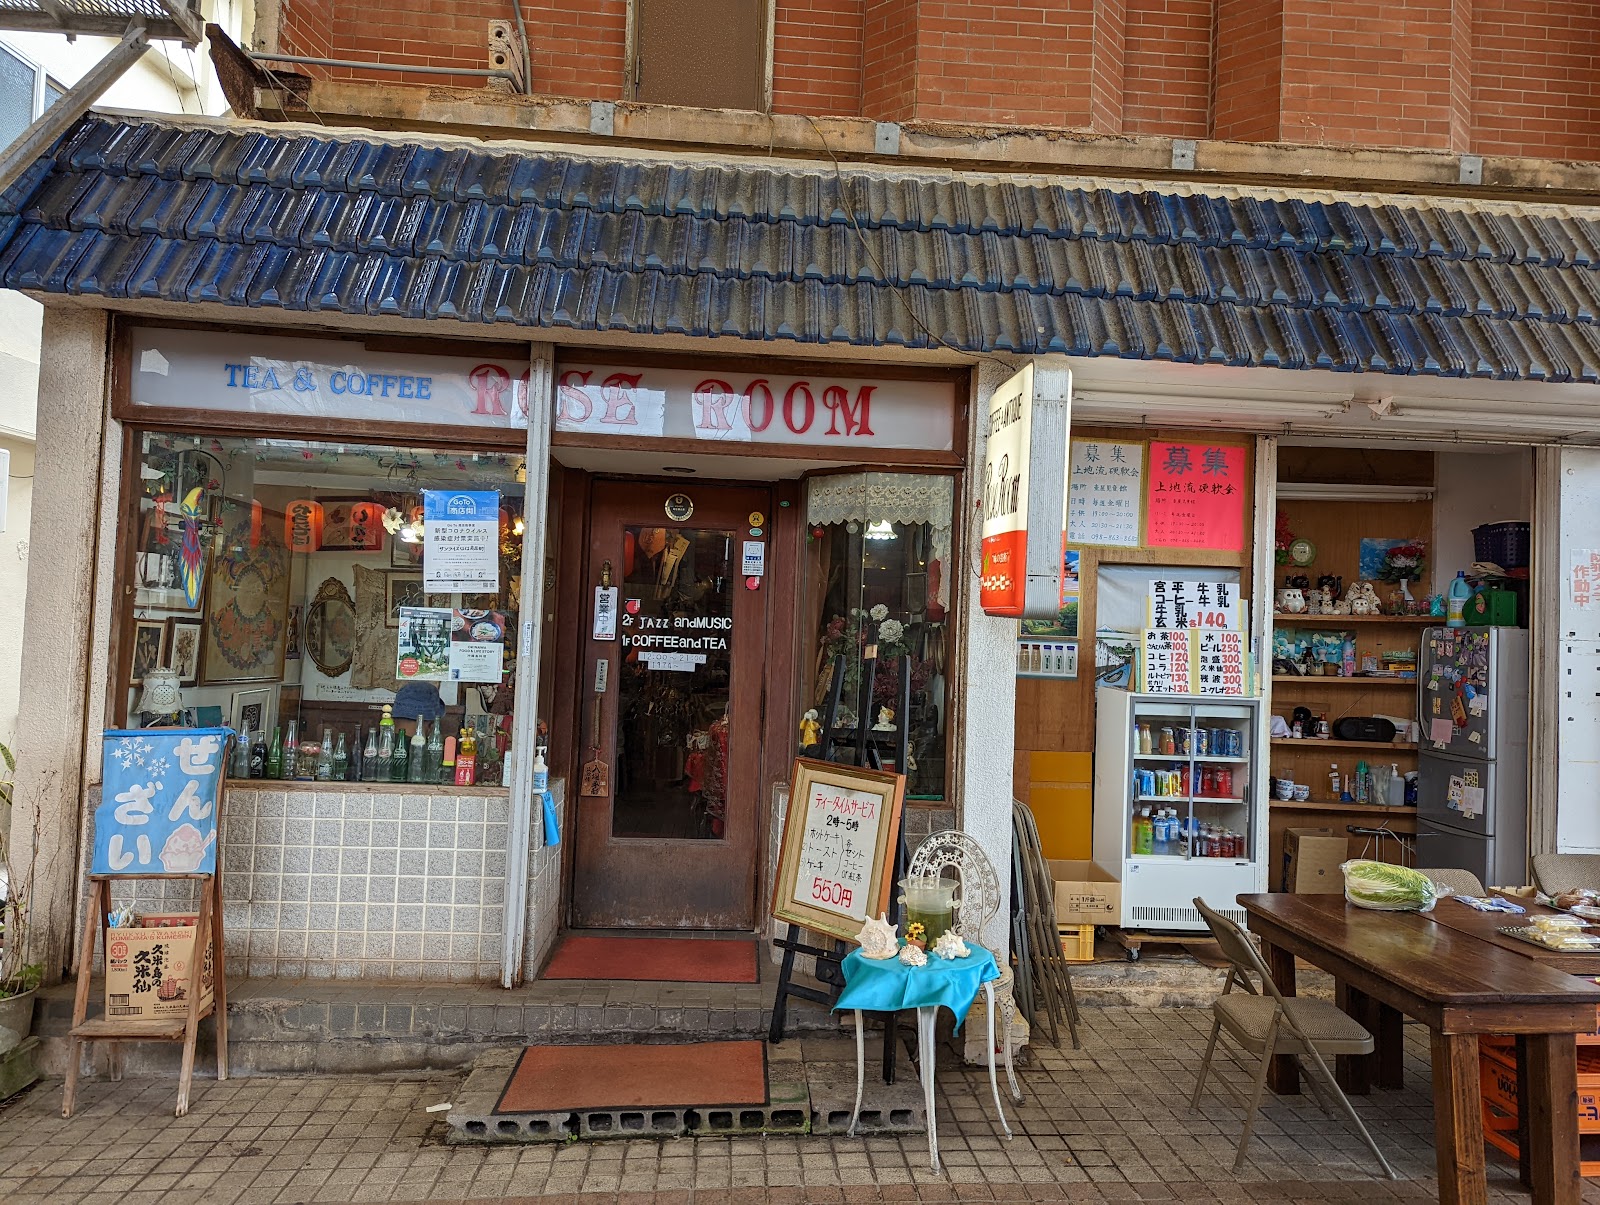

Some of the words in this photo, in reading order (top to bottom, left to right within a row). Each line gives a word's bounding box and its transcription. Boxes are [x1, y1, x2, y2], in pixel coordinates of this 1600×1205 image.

[225, 364, 281, 390] TEA
[293, 367, 317, 392] &
[329, 371, 432, 400] COFFEE
[693, 378, 878, 437] ROOM
[1085, 444, 1127, 463] 募集
[1162, 446, 1229, 476] 募集
[1070, 520, 1086, 528] 大人
[1573, 565, 1590, 607] 作動中
[599, 593, 611, 625] 営業中
[622, 613, 635, 627] 2F
[639, 617, 669, 630] JAZZ
[621, 634, 632, 647] 1F
[1205, 633, 1214, 643] 水
[815, 793, 875, 820] ティータイムサービス
[812, 876, 853, 909] 550円
[132, 950, 152, 993] 久米仙
